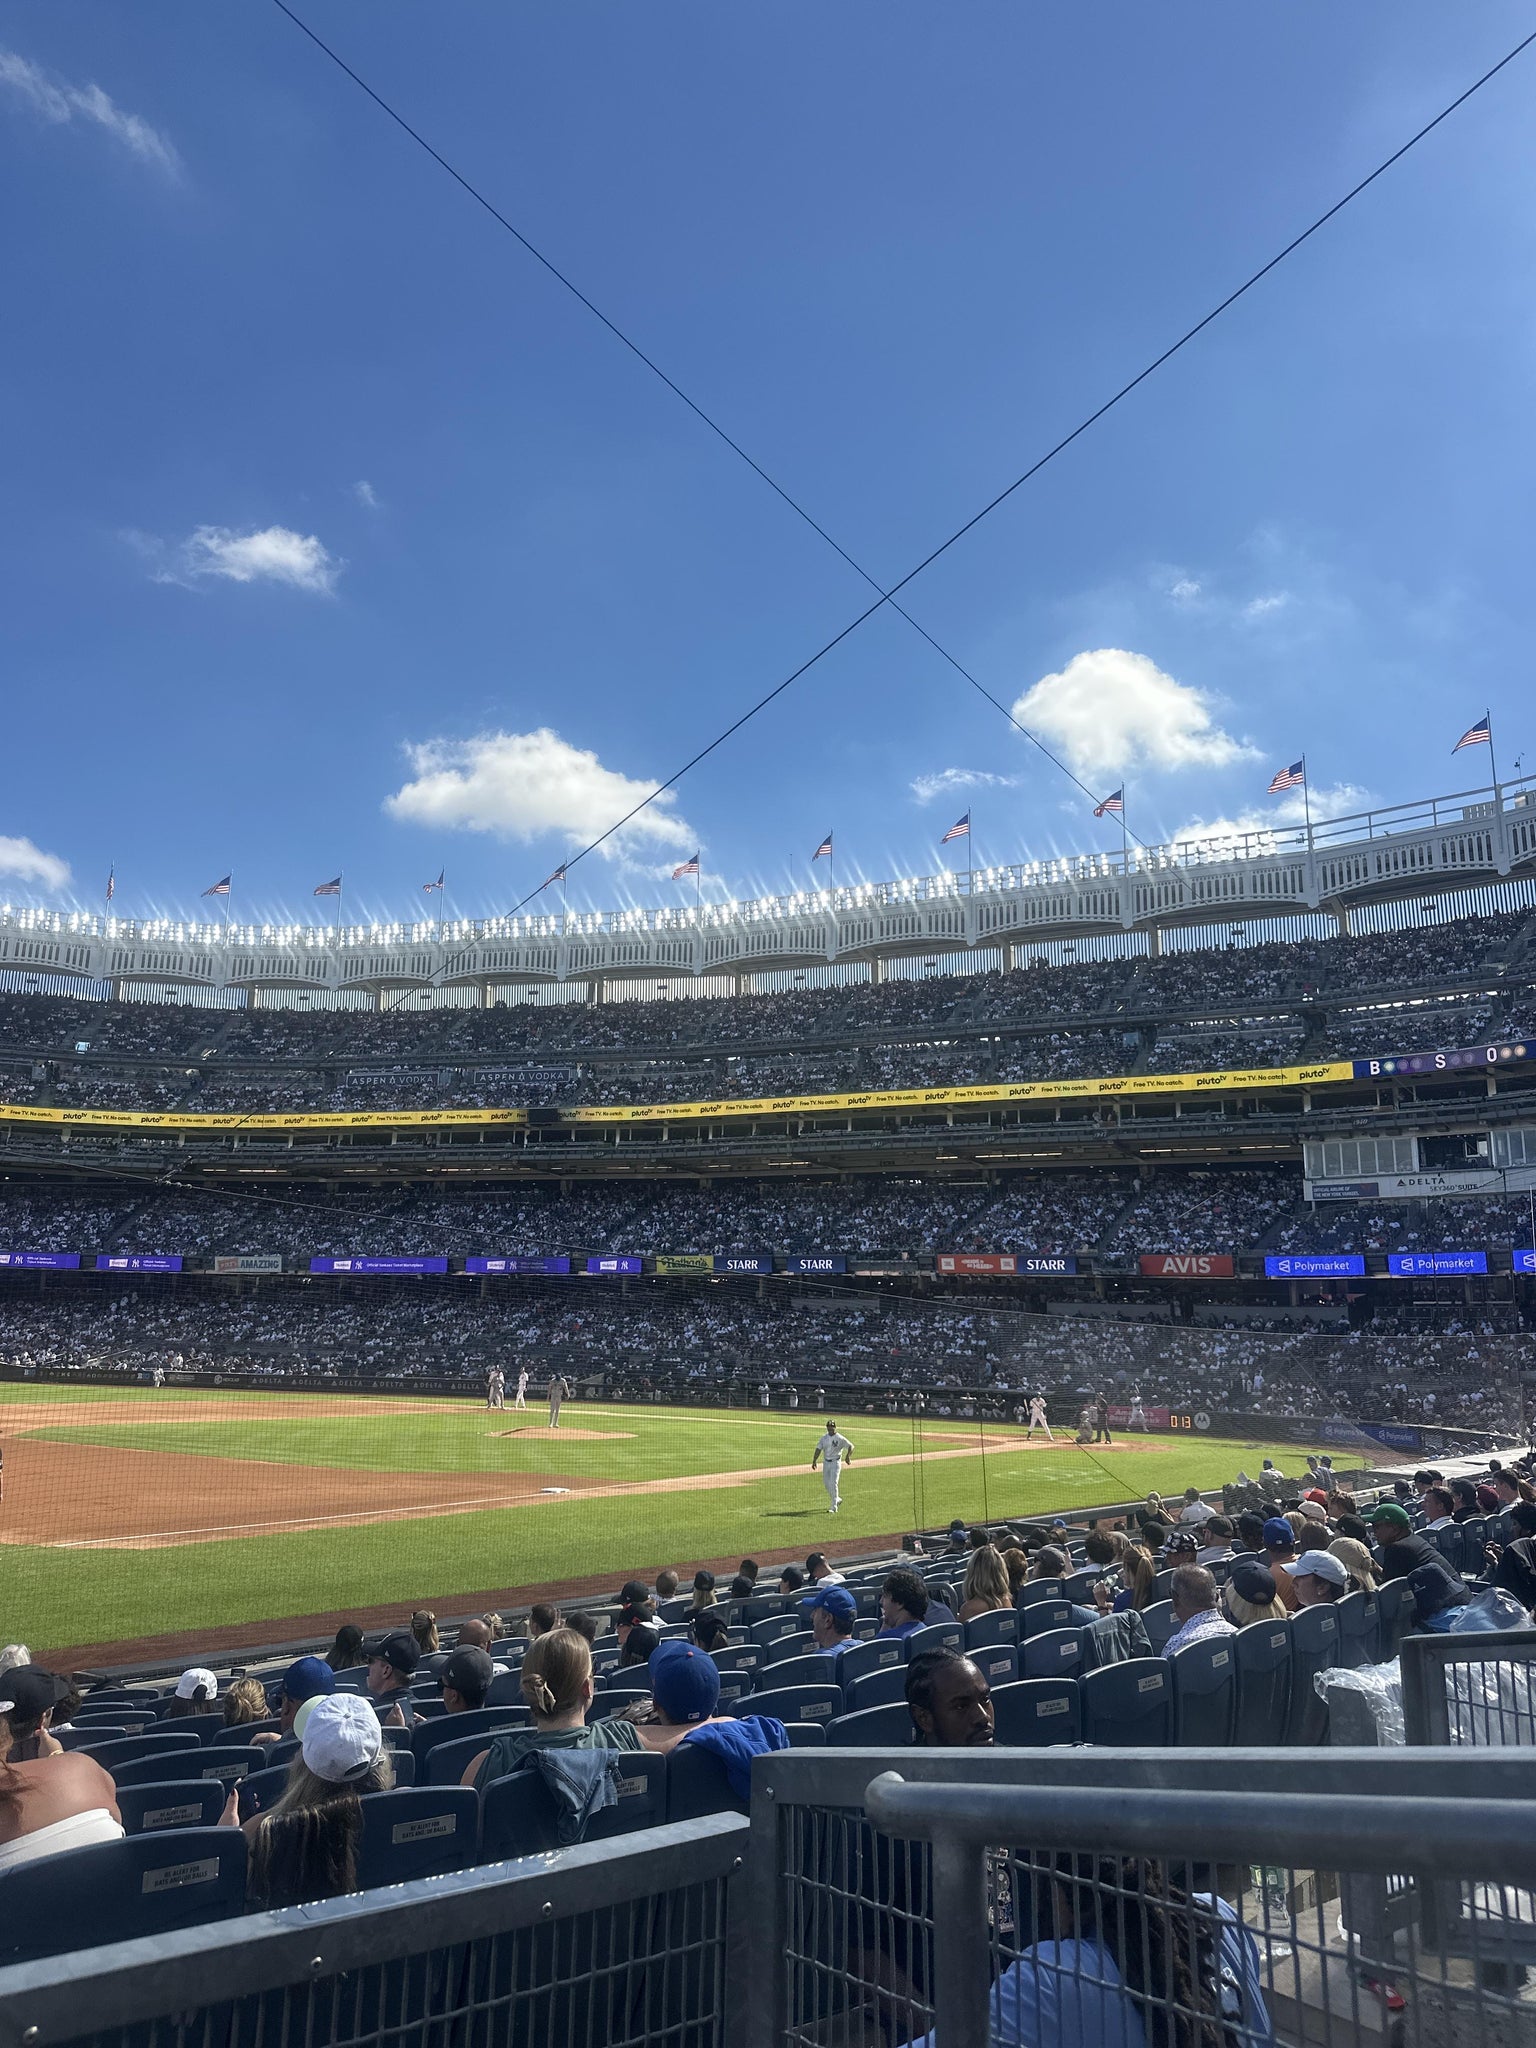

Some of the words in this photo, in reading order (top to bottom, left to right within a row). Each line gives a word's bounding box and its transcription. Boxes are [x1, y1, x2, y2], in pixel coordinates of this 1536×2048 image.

[1435, 1054, 1446, 1069] S
[1369, 1061, 1380, 1075] B
[352, 1077, 387, 1085] ASPEN
[399, 1076, 433, 1084] VODKA
[479, 1073, 515, 1082] ASPEN
[528, 1072, 564, 1081] VODKA
[1409, 1177, 1445, 1186] DELTA
[1457, 1183, 1479, 1191] SUITE
[240, 1259, 279, 1269] AMAZING
[661, 1256, 708, 1269] Nathan's
[727, 1259, 758, 1270] STARR
[800, 1259, 833, 1270] STARR
[1027, 1259, 1066, 1270] STARR
[1162, 1257, 1211, 1274] AVIS
[1295, 1260, 1349, 1273] Polymarket
[1418, 1259, 1474, 1272] Polymarket
[164, 1870, 172, 1878] BE
[173, 1868, 188, 1877] ALERT
[190, 1865, 199, 1873] FOR
[193, 1871, 207, 1880] BALLS
